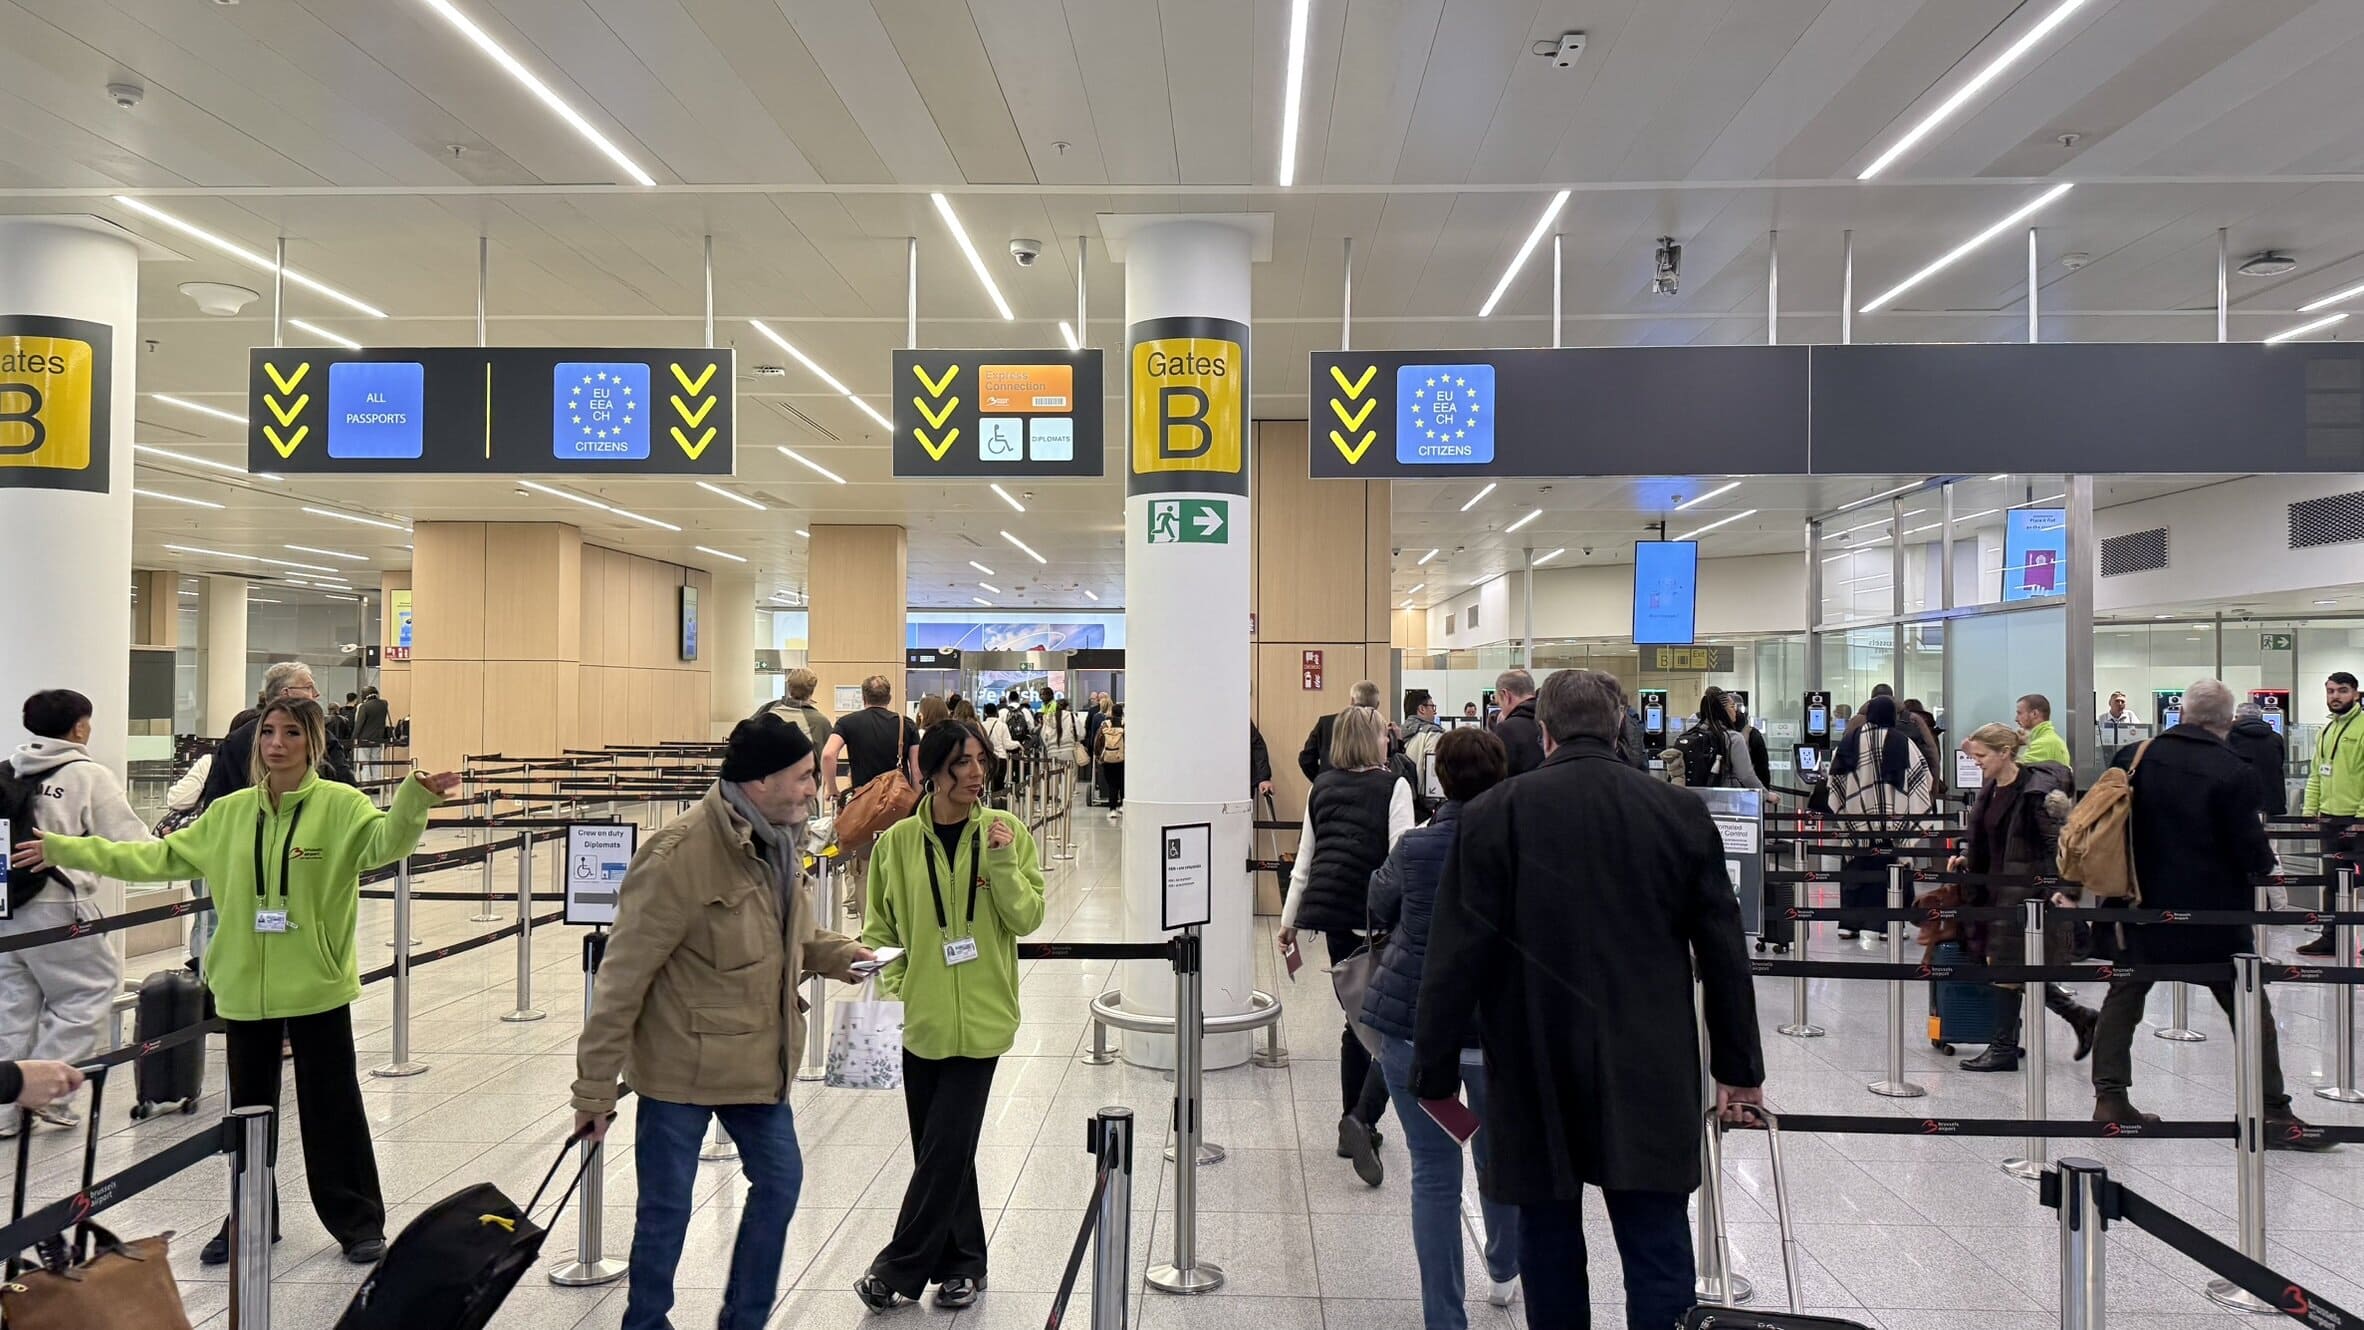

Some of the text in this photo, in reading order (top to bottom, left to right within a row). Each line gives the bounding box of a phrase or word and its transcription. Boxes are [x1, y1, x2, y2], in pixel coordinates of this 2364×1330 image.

[1, 349, 65, 375] ates
[1147, 352, 1226, 377] Gates
[985, 371, 1028, 382] Express
[985, 381, 1046, 391] Connection
[366, 393, 387, 403] ALL
[593, 388, 610, 398] EU
[1436, 391, 1453, 401] EU
[589, 400, 614, 410] EEA
[1433, 402, 1457, 413] EEA
[0, 383, 46, 455] B
[346, 413, 407, 424] PASSPORTS
[592, 411, 610, 421] CH
[1436, 414, 1454, 425] CH
[1159, 386, 1213, 459] B
[575, 441, 629, 452] CITIZENS
[1418, 445, 1472, 456] CITIZENS
[577, 829, 594, 837] Crew
[607, 829, 624, 838] duty
[584, 841, 621, 850] Diplomats
[89, 1180, 117, 1200] brussels
[90, 1190, 113, 1208] airport
